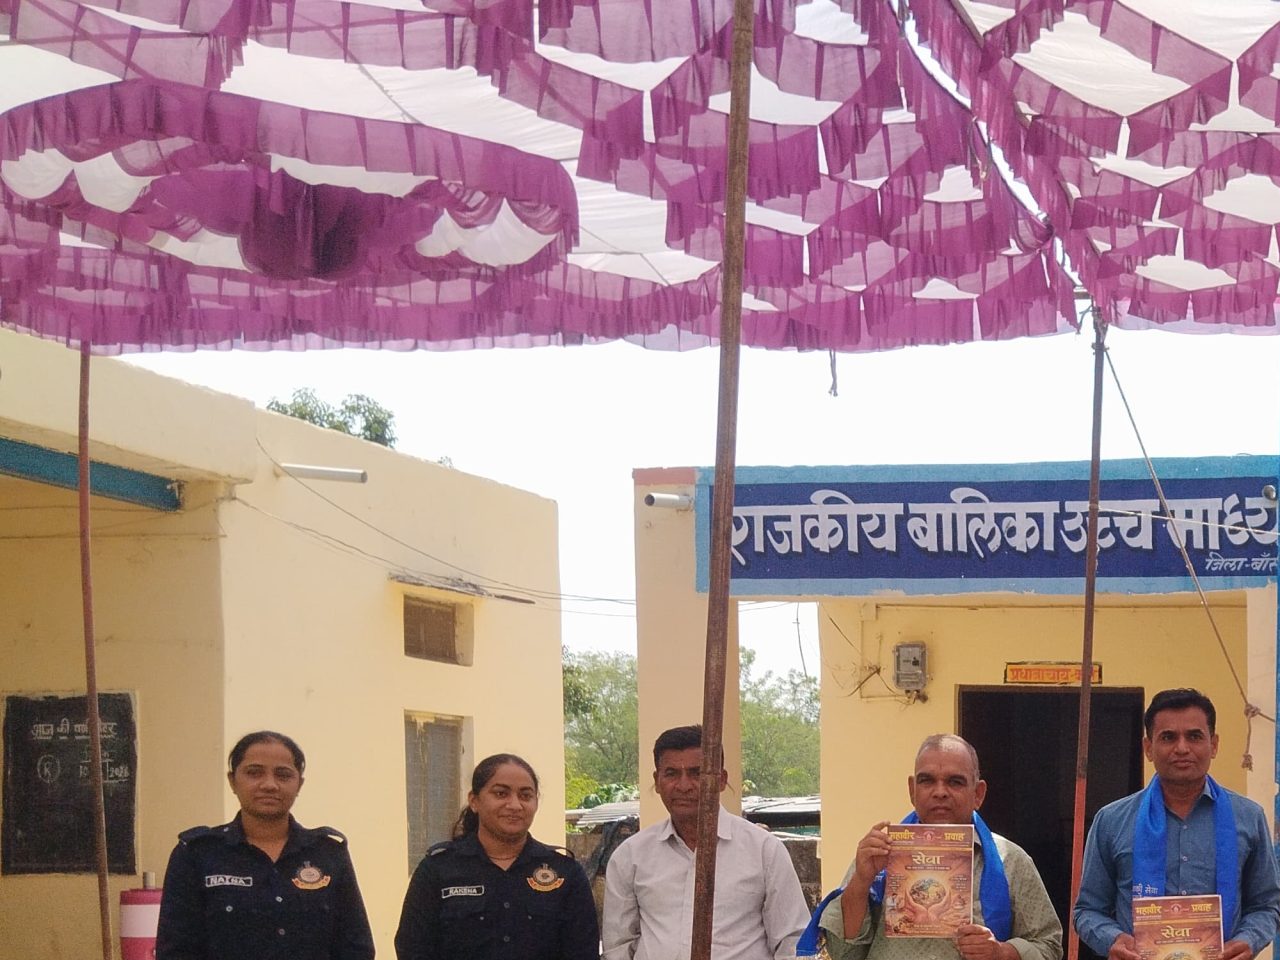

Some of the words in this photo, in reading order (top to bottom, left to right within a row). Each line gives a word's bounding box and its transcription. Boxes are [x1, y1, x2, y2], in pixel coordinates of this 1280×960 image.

[907, 486, 1060, 560] बालिका
[912, 851, 944, 865] सेवा
[1161, 925, 1193, 938] सेवा
